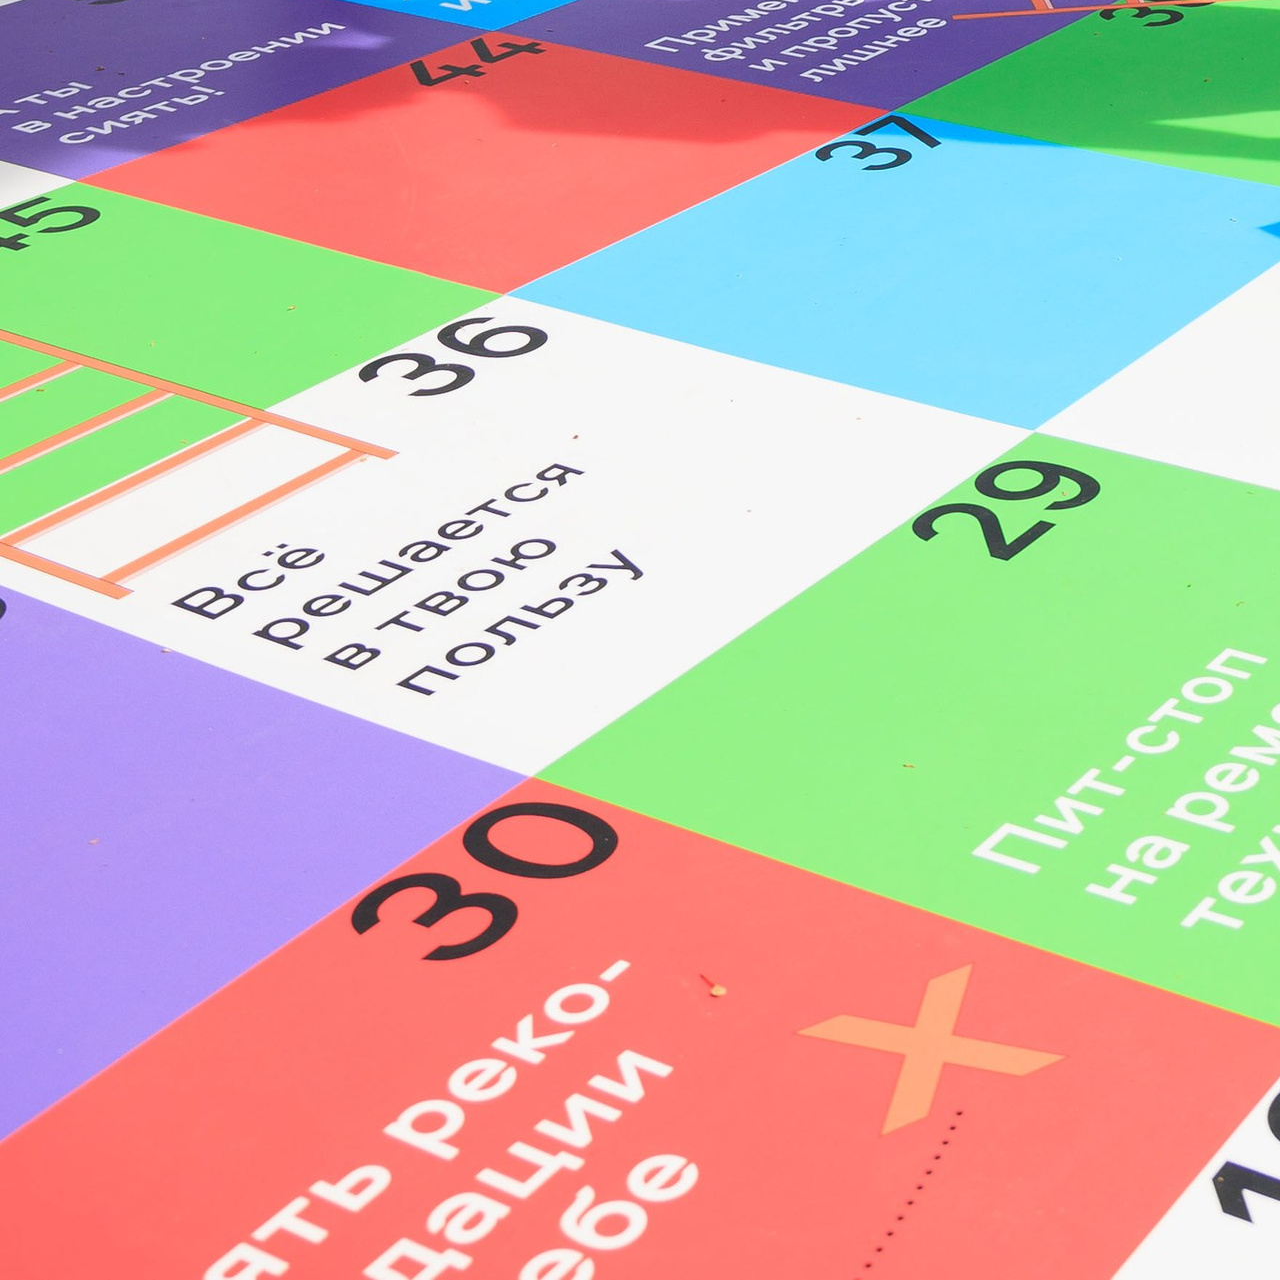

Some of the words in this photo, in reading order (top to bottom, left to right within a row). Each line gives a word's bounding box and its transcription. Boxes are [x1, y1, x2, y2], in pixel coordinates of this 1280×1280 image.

[12, 120, 53, 133] в
[53, 21, 346, 120] настроении
[409, 38, 547, 88] 44
[749, 58, 788, 72] и
[800, 17, 947, 82] лишнее
[14, 81, 93, 105] ты
[59, 85, 225, 144] сиять!
[814, 114, 943, 172] 37
[357, 317, 549, 397] 36
[911, 460, 1101, 561] 29
[171, 543, 325, 620] Всё
[252, 462, 586, 652] решается
[323, 642, 382, 672] в
[375, 536, 557, 635] твою
[395, 548, 646, 698] пользу
[971, 647, 1269, 876] Пит-стоп
[351, 802, 619, 961] 30
[1084, 836, 1190, 906] на
[382, 959, 631, 1161] реко-
